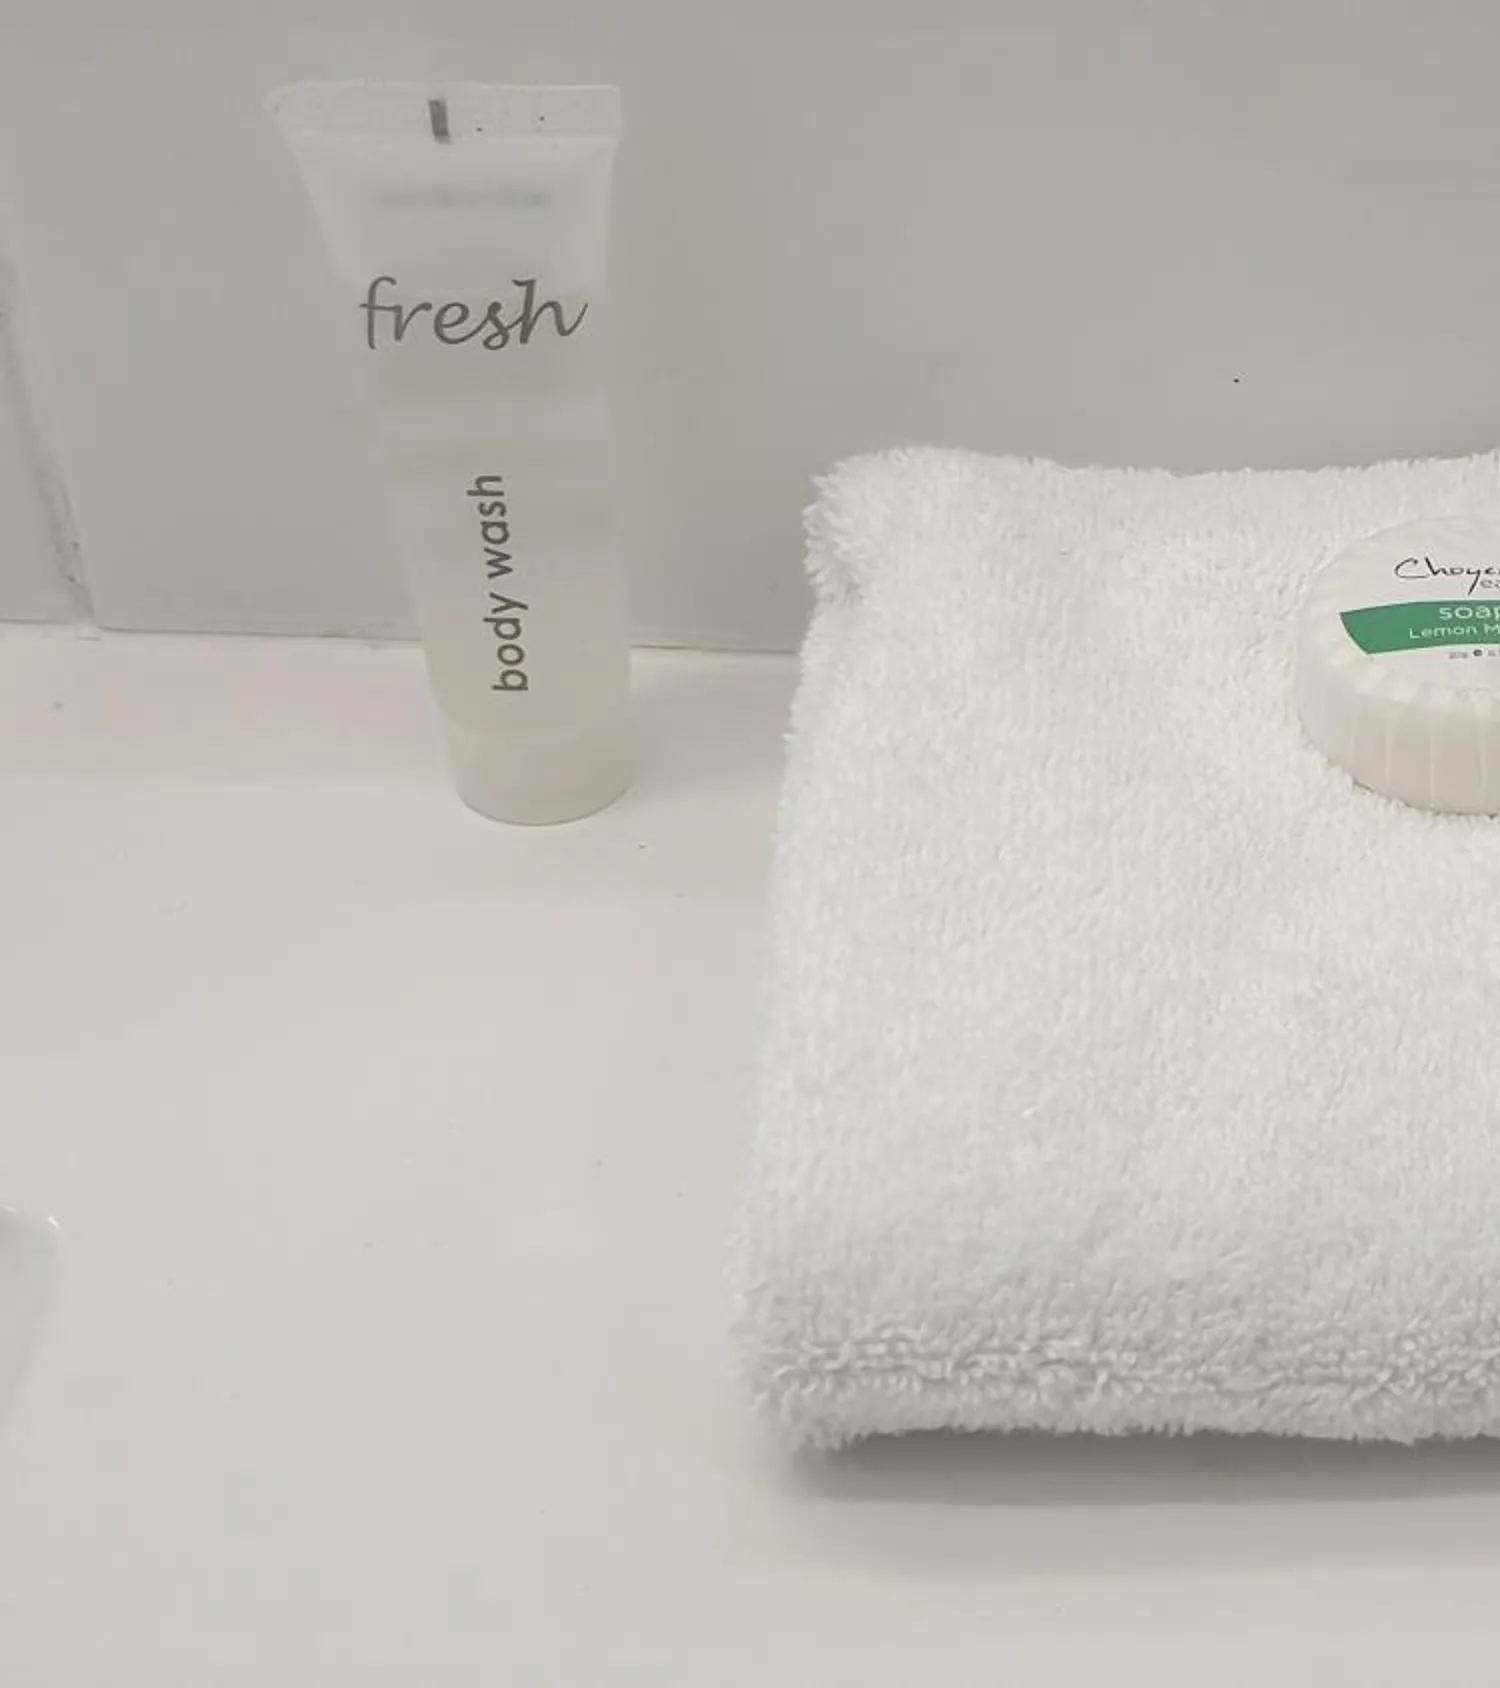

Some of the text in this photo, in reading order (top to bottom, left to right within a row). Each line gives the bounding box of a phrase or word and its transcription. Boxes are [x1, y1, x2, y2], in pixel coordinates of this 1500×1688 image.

[358, 275, 589, 351] fresh
[465, 475, 529, 692] body wash
[1408, 624, 1478, 640] Lemon
